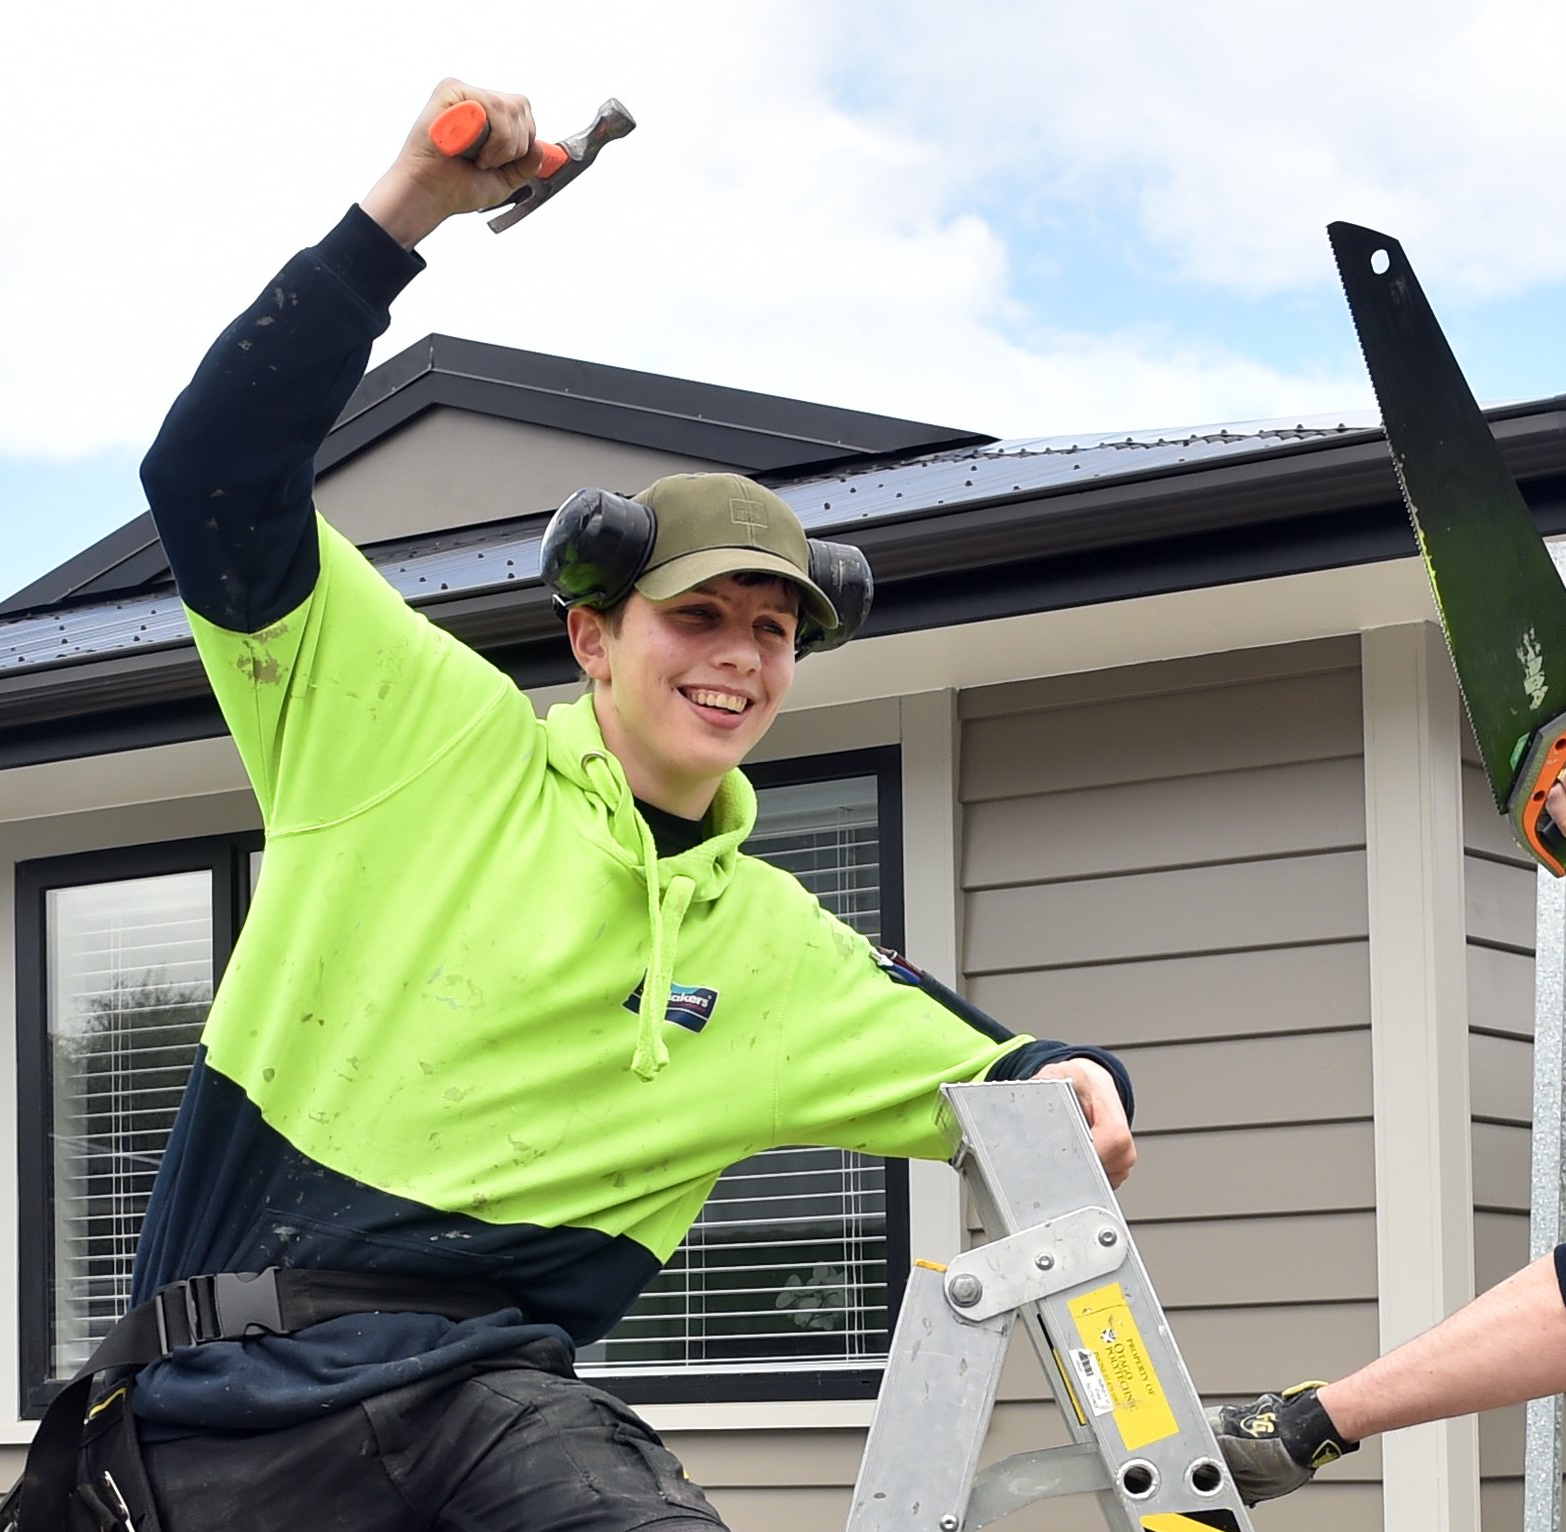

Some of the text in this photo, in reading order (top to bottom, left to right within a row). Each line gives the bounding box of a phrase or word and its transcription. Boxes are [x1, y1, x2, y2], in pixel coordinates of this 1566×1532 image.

[668, 992, 709, 1008] akers
[1126, 1338, 1155, 1395] PROPERTY OF
